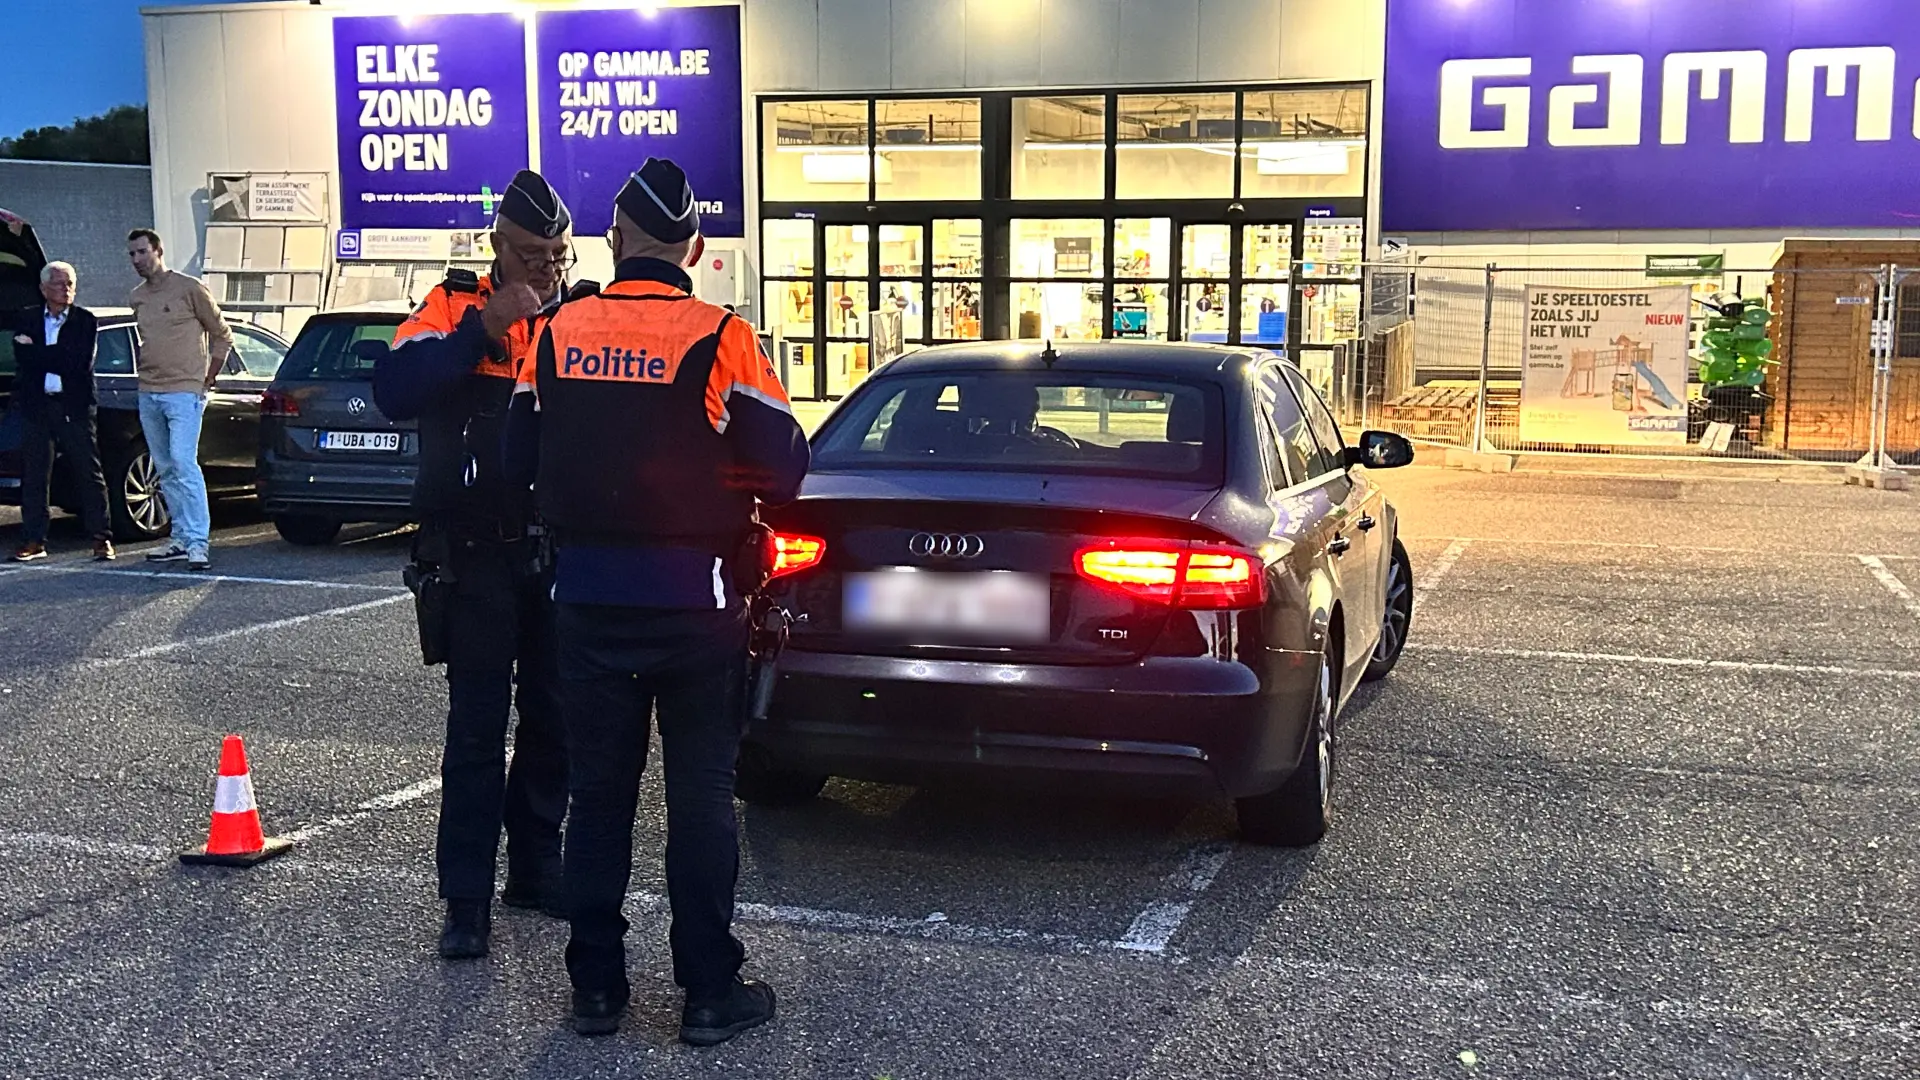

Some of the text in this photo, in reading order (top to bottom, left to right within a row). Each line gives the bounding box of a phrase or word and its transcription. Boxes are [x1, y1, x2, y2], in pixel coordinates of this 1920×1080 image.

[356, 44, 440, 83] ELKE
[558, 49, 710, 78] OP GAMMA.BE
[358, 87, 493, 128] ZONDAG
[559, 80, 657, 107] ZIJN WIJ
[560, 108, 678, 138] 24/7 OPEN
[360, 133, 448, 171] OPEN
[1531, 293, 1652, 307] JE SPEELTOESTEL
[1530, 309, 1600, 322] ZOALS JIJ
[1645, 314, 1684, 326] NIEUW
[1530, 324, 1592, 338] HET WILT
[564, 346, 666, 379] Politie
[1098, 629, 1128, 639] TDI
